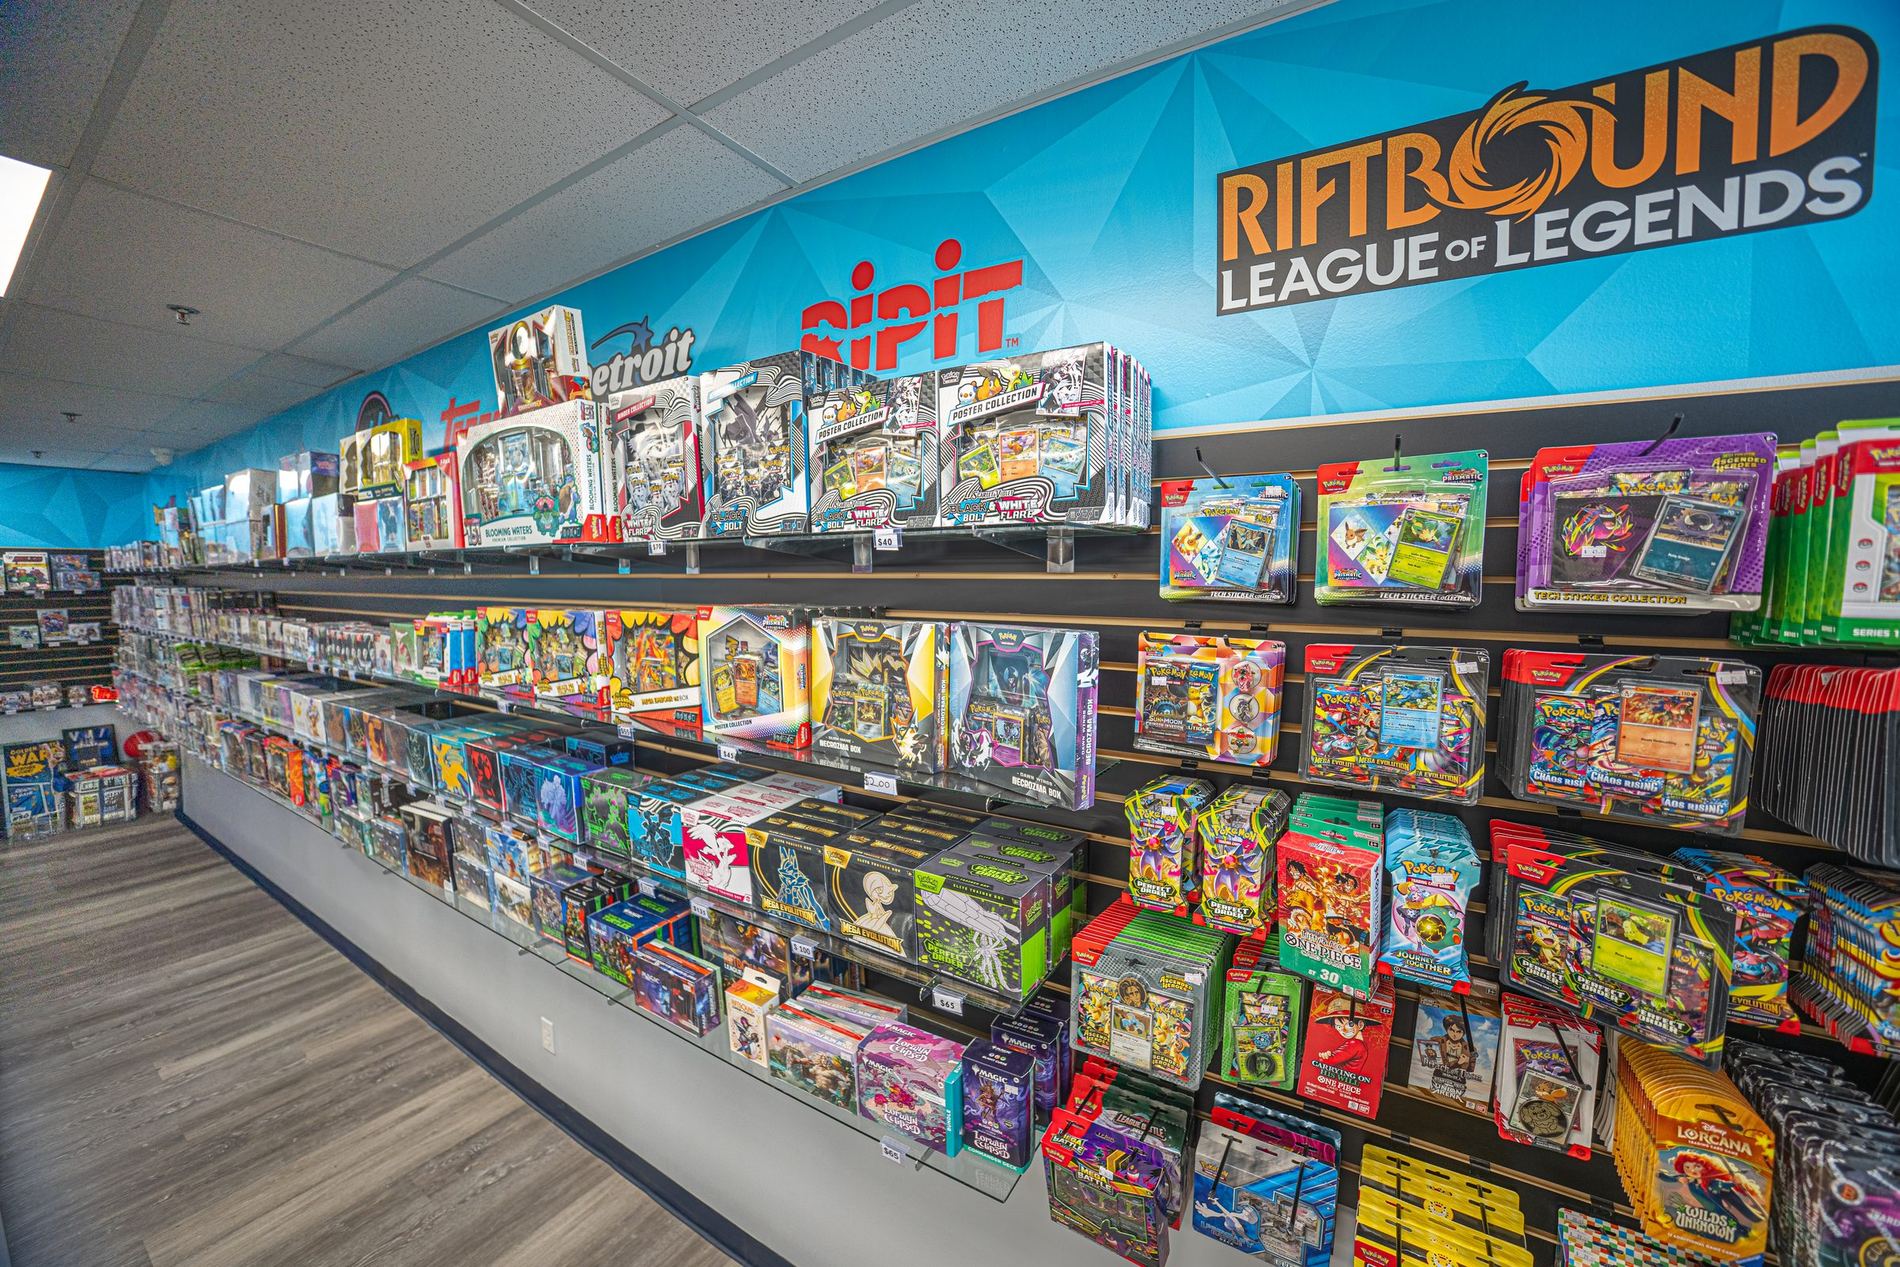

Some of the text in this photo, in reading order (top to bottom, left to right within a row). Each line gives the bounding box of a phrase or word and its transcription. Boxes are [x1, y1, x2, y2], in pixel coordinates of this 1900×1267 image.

[1222, 33, 1869, 261] RIFTBOUND
[1220, 155, 1864, 311] LEAGUE OF LEGENDS
[588, 327, 695, 398] etroit
[953, 387, 1038, 421] POSTER COLLECTION
[819, 410, 884, 439] POSTER COLLECTION
[1712, 456, 1767, 466] ASCENDED
[1716, 462, 1757, 473] HEROES
[1542, 465, 1575, 473] Pokémon
[950, 503, 987, 512] BLACK
[999, 500, 1038, 511] WHITE
[854, 509, 886, 519] WHITE
[963, 510, 1034, 522] BOLT FLARE
[724, 521, 743, 531] BOLT
[827, 518, 882, 529] BOLT FLARE
[485, 525, 533, 538] BLOOMING WATERS
[628, 527, 650, 536] FLARE
[878, 538, 893, 546] $40
[1534, 591, 1687, 604] TECH STICKER COLLECTION
[1852, 627, 1890, 637] SERIES
[1150, 666, 1187, 679] Pokémon
[1531, 670, 1562, 680] Pokémon
[729, 719, 752, 728] COLLECTION
[1163, 717, 1183, 725] MOON
[819, 740, 861, 754] NECROZMA BOX
[1358, 757, 1411, 771] MEGA EVOLUTION
[1426, 771, 1461, 784] EVOLUTION
[1533, 771, 1563, 783] CHAOS
[1590, 772, 1658, 792] CHAOS RISING
[1011, 776, 1062, 800] NECROZMA BOX
[1687, 801, 1724, 815] RISING
[1214, 823, 1258, 840] Pokémon
[1516, 862, 1545, 876] Pokémon
[1137, 880, 1172, 893] PERFECT
[1140, 887, 1167, 898] ORDER
[1712, 888, 1783, 911] Pokémon
[762, 898, 814, 922] MEGA EVOLUTION
[1210, 900, 1250, 916] PERFECT
[1214, 907, 1244, 920] ORDER
[842, 923, 902, 950] MEGA EVOLUTION
[927, 942, 968, 960] PERFECT
[1284, 931, 1319, 953] ONE
[1319, 946, 1362, 970] PIECE
[1396, 951, 1434, 964] JOURNEY
[932, 950, 964, 968] ORDER
[1405, 959, 1452, 975] TOGETHER
[1521, 960, 1564, 981] PERFECT
[1160, 976, 1193, 991] ASCENDED
[1320, 968, 1341, 984] 30
[1526, 967, 1559, 986] ORDER
[1577, 976, 1625, 998] PERFECT
[1581, 984, 1619, 1005] ORDER
[940, 999, 955, 1009] $65
[1732, 997, 1781, 1015] EVOLUTION
[1640, 1009, 1686, 1030] ERFECT
[891, 1025, 916, 1037] MAGIC
[1008, 1037, 1036, 1051] MAGIC
[868, 1060, 893, 1073] MAGIC
[1312, 1060, 1371, 1083] CARRYING ON
[979, 1069, 1008, 1084] MAGIC
[1320, 1069, 1359, 1086] HIS WILL
[1317, 1075, 1337, 1087] ONE
[1337, 1082, 1362, 1095] PIECE
[1115, 1113, 1141, 1127] LEAGUE
[1701, 1121, 1727, 1136] Disney
[1052, 1135, 1084, 1154] BATTLE
[1677, 1125, 1752, 1157] LORCANA
[883, 1147, 899, 1160] $65
[968, 1146, 1017, 1171] COMMANDER DECK
[1724, 1148, 1738, 1156] GAME
[1077, 1171, 1112, 1192] BATTLE
[1079, 1165, 1108, 1183] MEGA
[1684, 1205, 1728, 1227] WILDS
[1676, 1211, 1737, 1243] UNKNOWN
